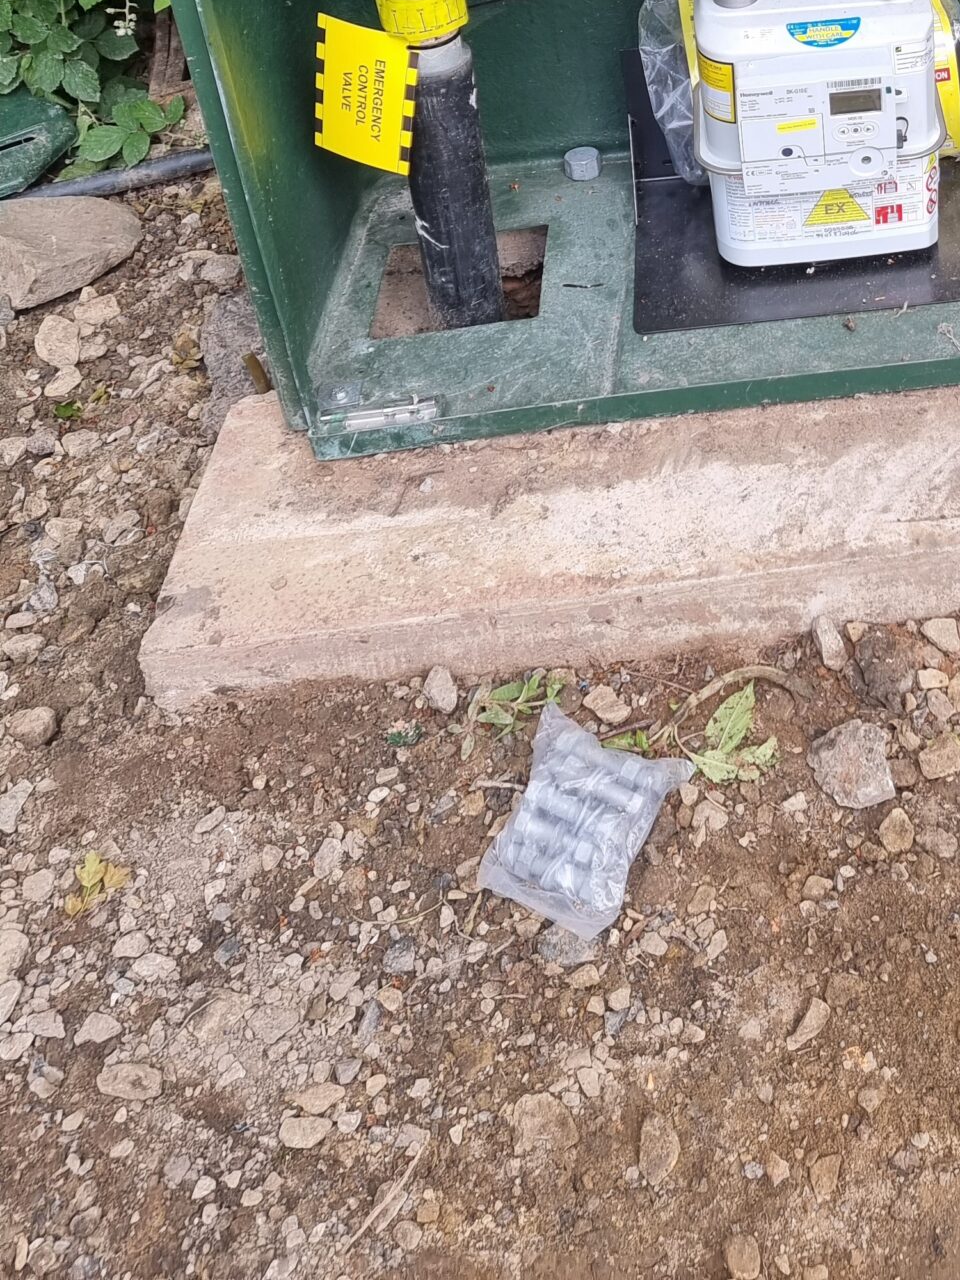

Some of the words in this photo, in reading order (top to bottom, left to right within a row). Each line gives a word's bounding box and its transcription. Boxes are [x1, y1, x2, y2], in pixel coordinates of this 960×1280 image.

[808, 25, 839, 33] HANDLE
[341, 71, 353, 112] VALVE
[355, 64, 369, 126] CONTROL
[371, 59, 386, 143] EMERGENCY
[740, 90, 773, 98] Honeywell
[824, 202, 846, 215] EX
